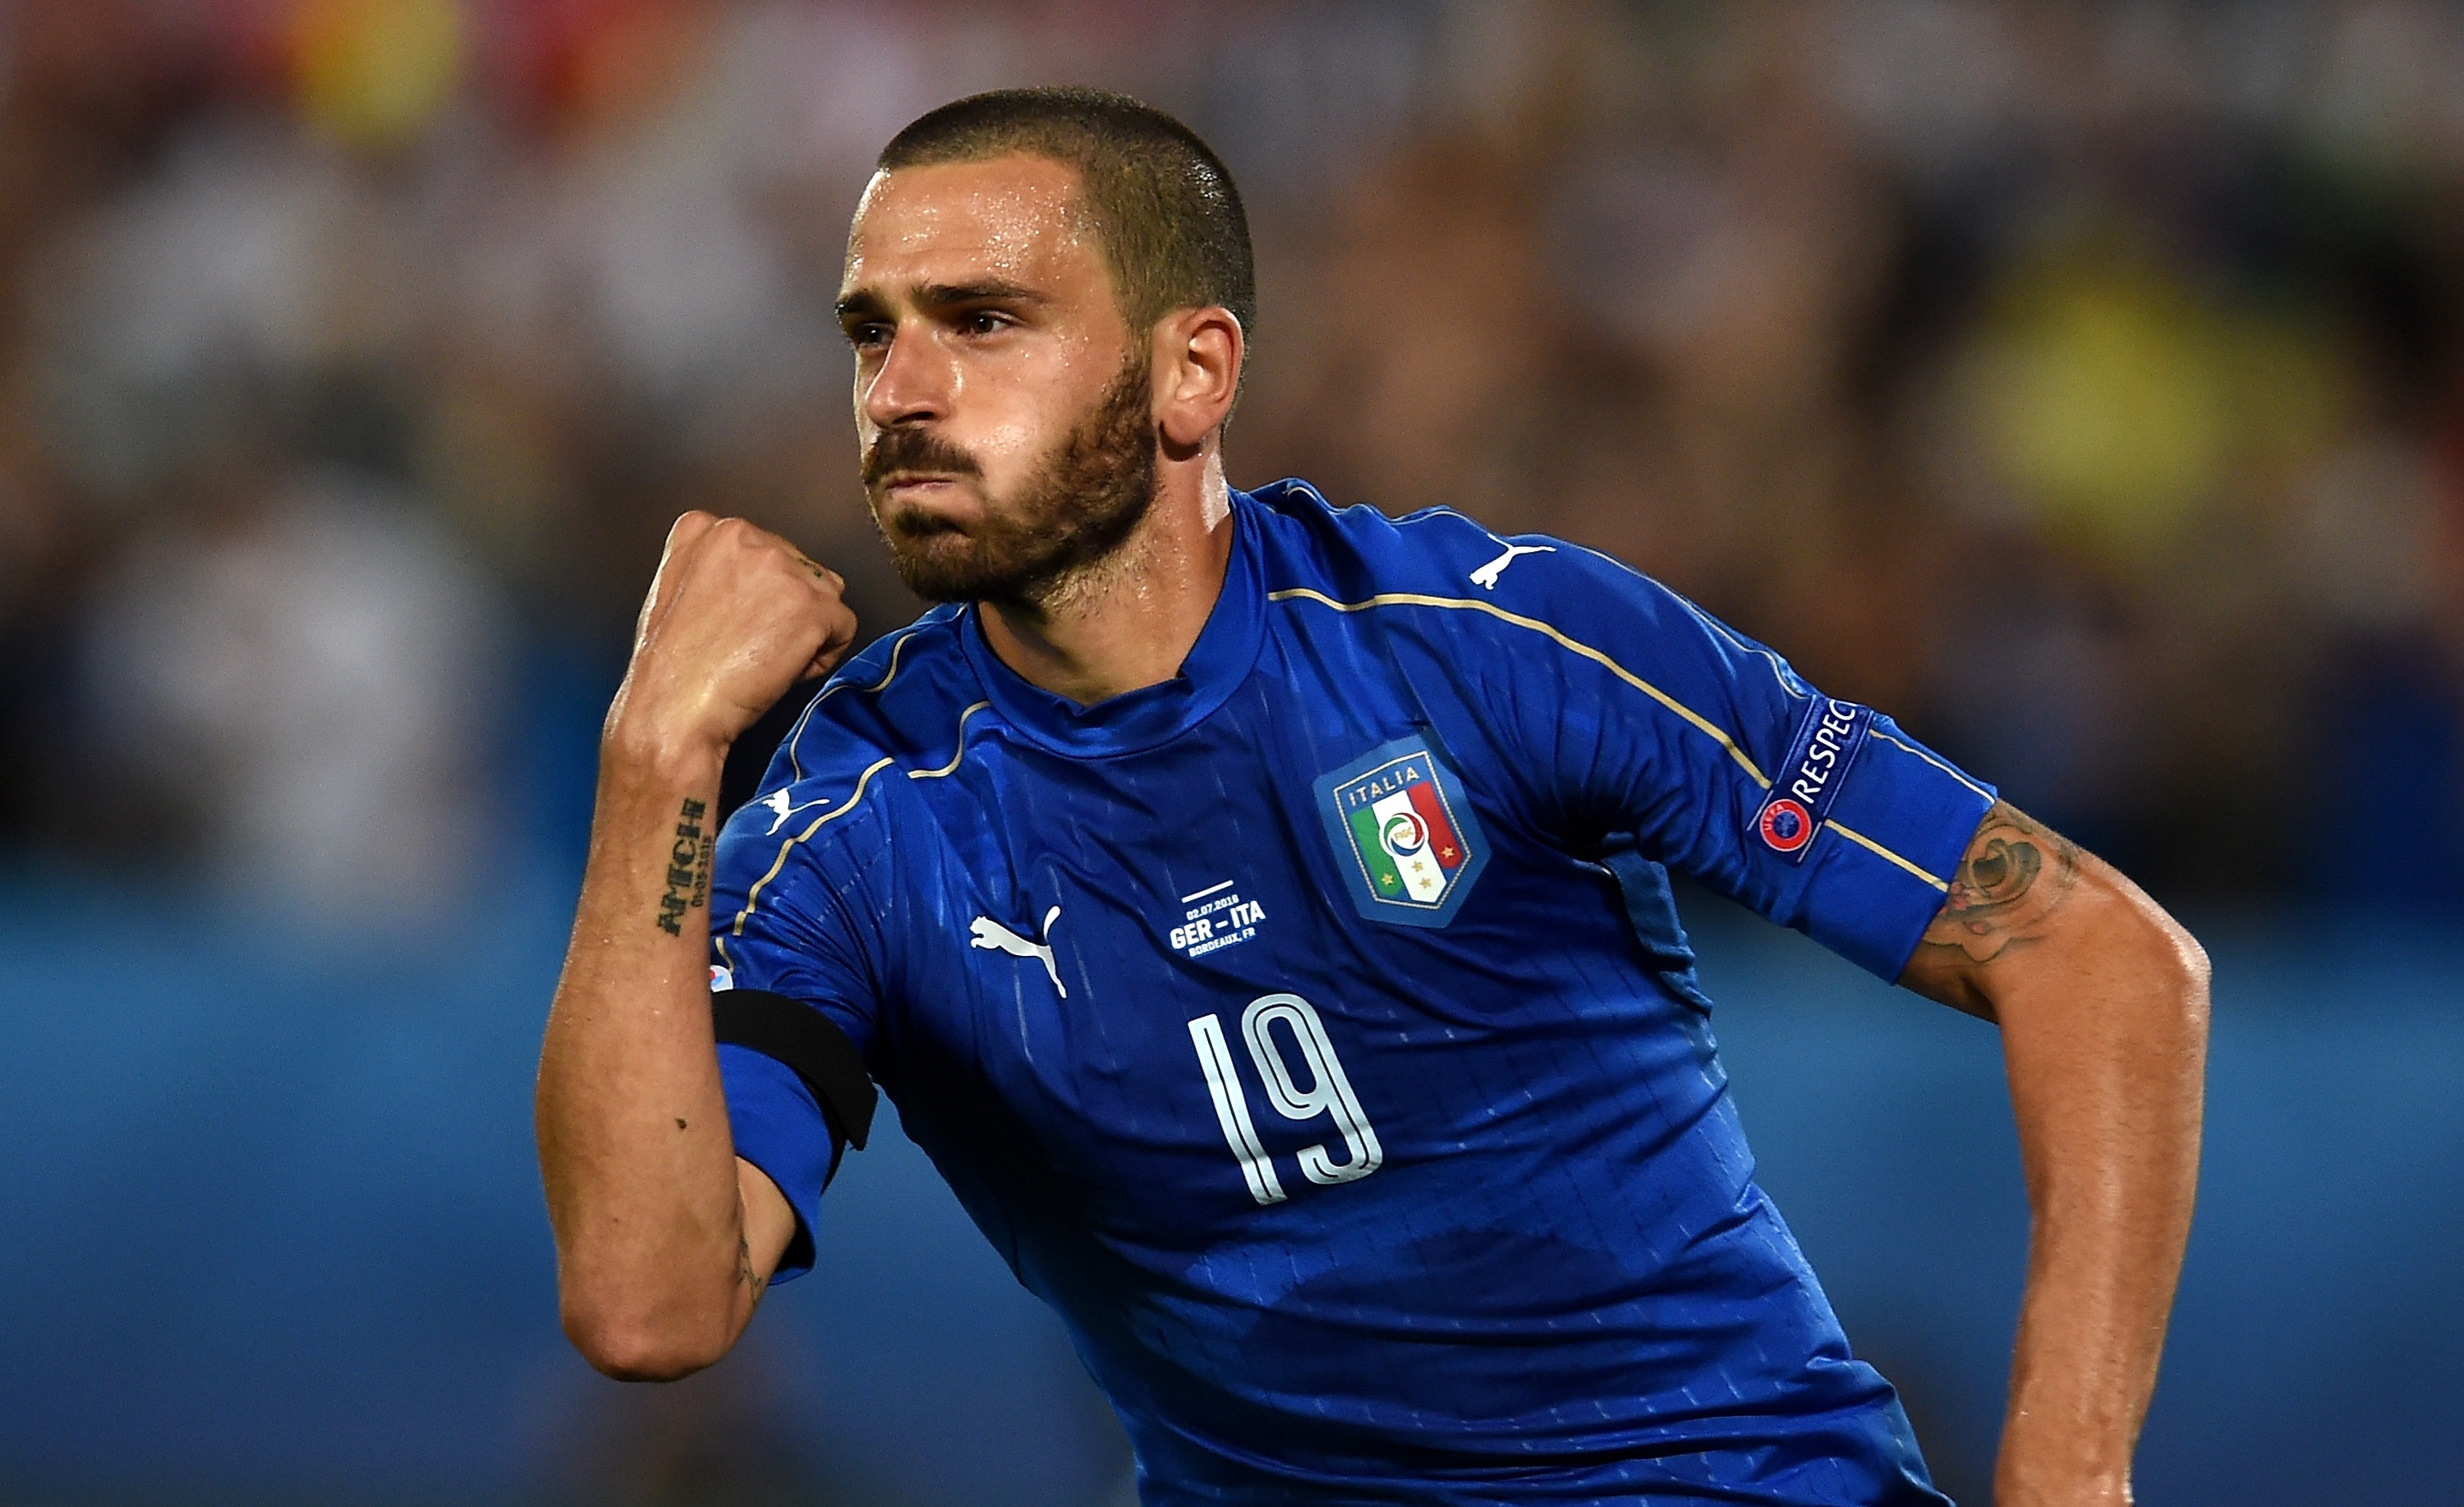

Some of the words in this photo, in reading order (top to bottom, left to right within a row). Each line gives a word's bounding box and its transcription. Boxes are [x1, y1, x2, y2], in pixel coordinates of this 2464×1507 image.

[1348, 765, 1420, 806] ITALIA
[1170, 918, 1214, 949] GER
[1230, 900, 1266, 929] ITA
[1186, 894, 1239, 921] 02.07.2016
[1242, 927, 1256, 939] FR
[1188, 993, 1383, 1206] 19
